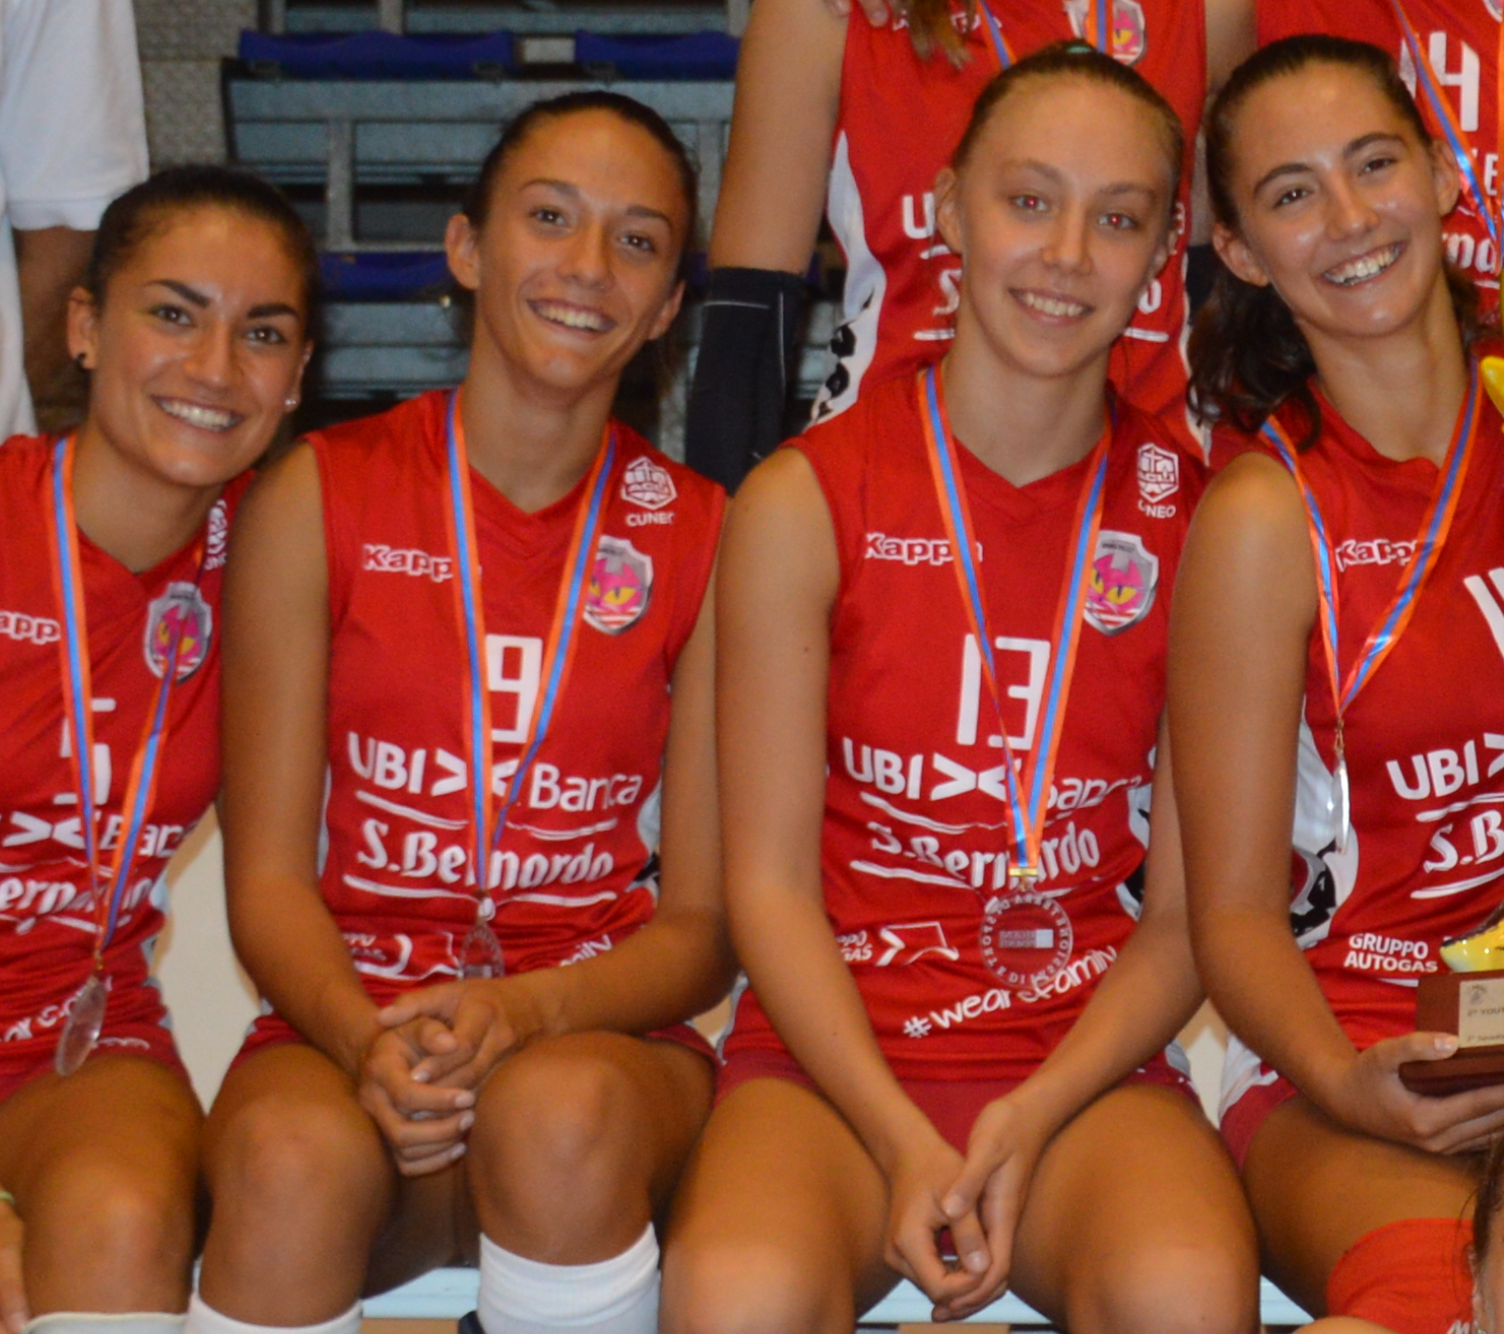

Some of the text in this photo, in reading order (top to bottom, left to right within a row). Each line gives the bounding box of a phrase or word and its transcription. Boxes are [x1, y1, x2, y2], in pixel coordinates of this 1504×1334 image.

[362, 544, 456, 583] Kapp
[485, 633, 543, 745] 9
[956, 633, 1052, 750] 13
[347, 731, 643, 813] UBI Banca
[842, 737, 924, 801] UBI
[1386, 747, 1480, 803] UBI
[356, 818, 615, 891] S.Benardo
[1343, 952, 1439, 974] AUTOGAS
[1349, 932, 1429, 961] GRUPPO
